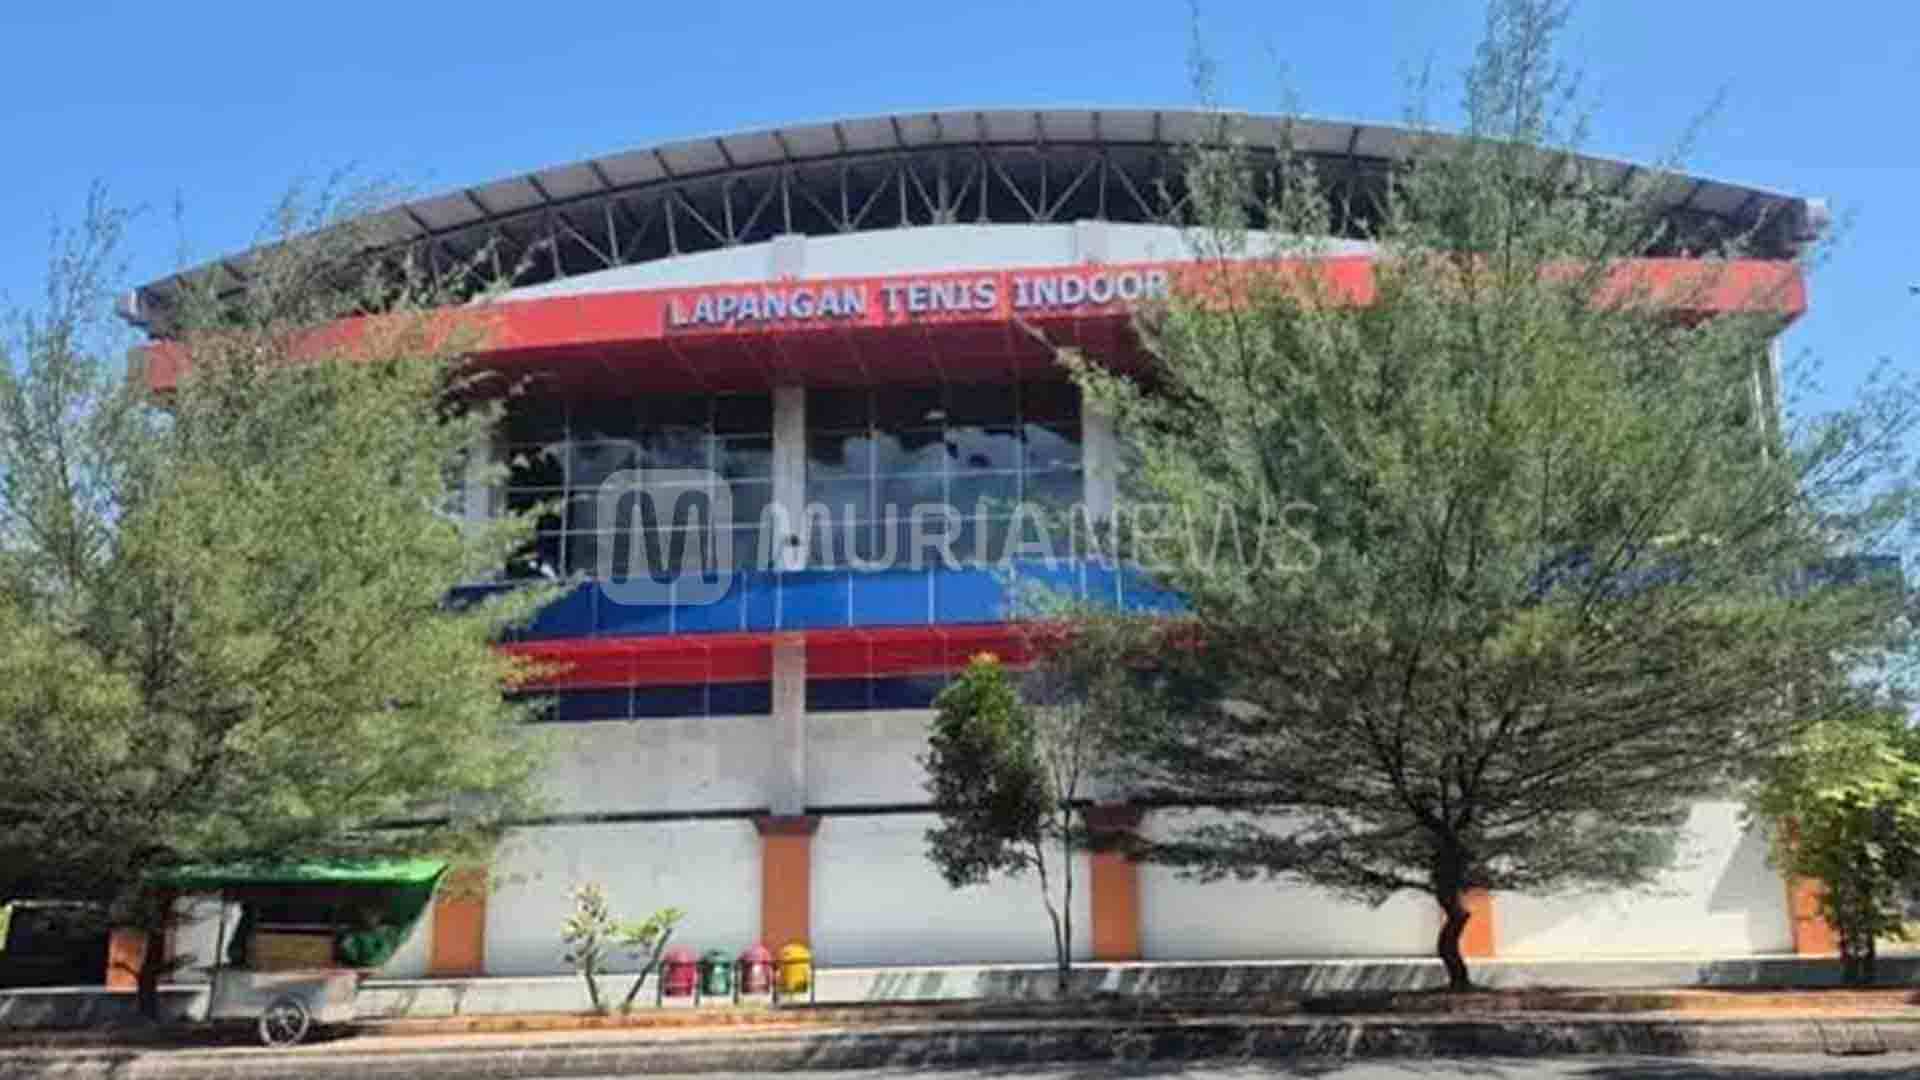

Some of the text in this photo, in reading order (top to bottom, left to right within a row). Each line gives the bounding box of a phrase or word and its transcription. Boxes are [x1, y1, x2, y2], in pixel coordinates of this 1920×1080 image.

[669, 269, 1170, 326] LAPANGAN TENIS INDOOR
